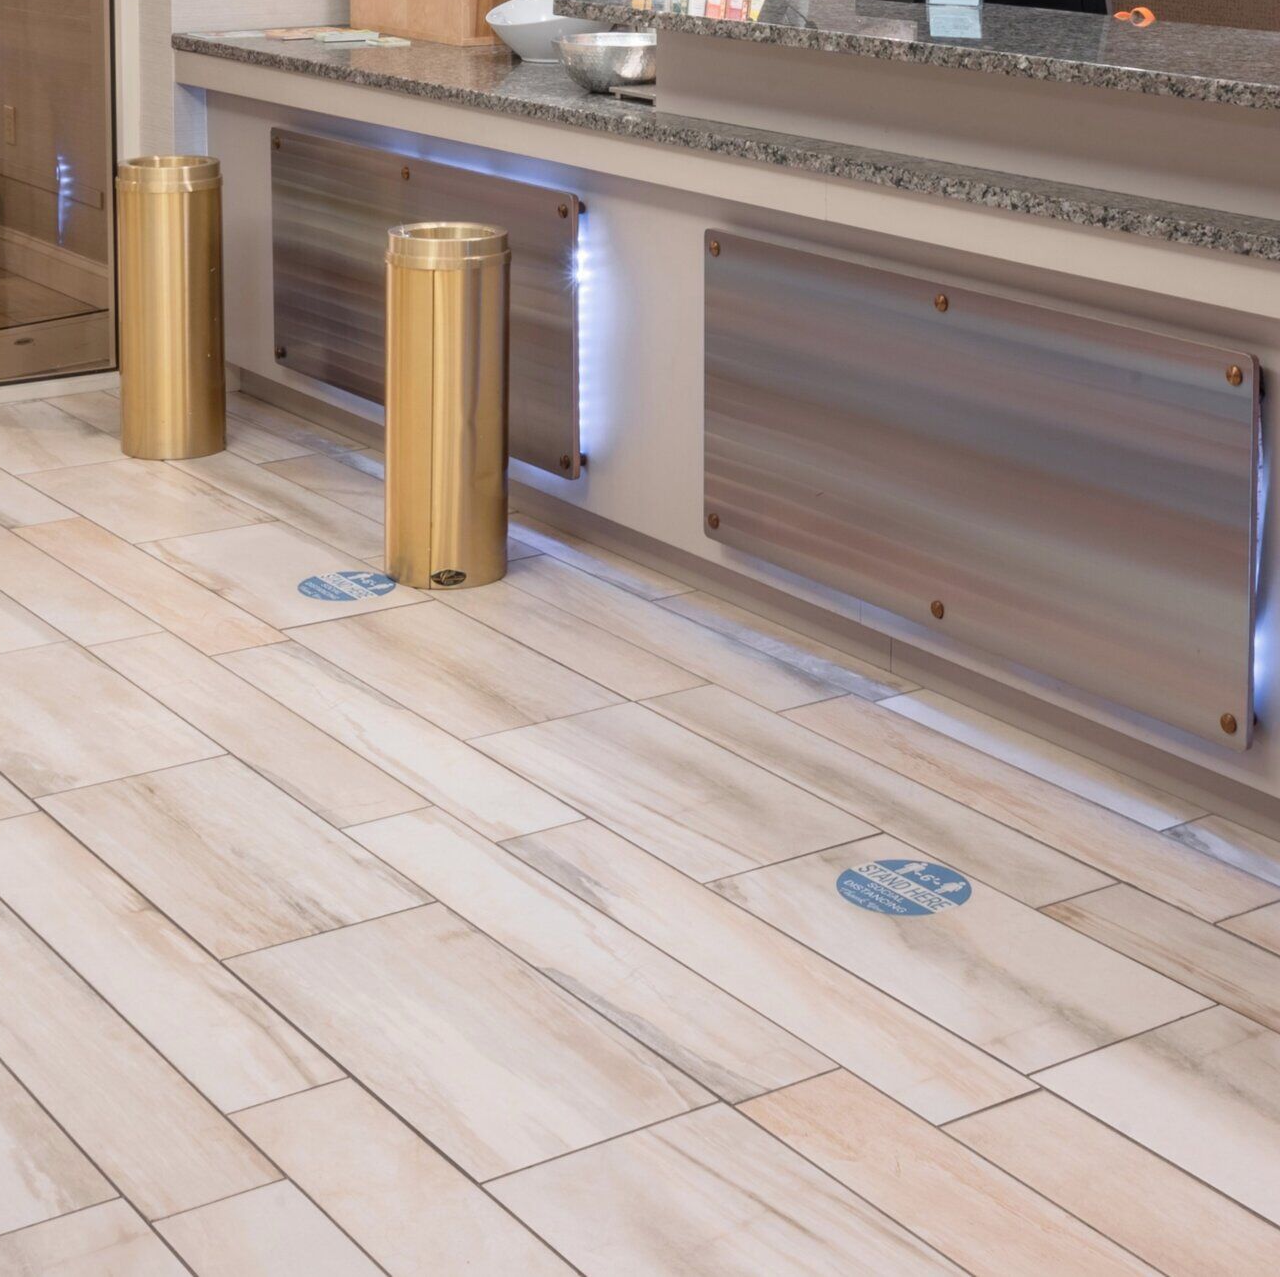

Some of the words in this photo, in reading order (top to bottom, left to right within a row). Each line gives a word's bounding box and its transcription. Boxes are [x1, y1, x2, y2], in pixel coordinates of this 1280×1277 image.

[843, 879, 908, 913] DISTANCING
[858, 864, 912, 890] STAND
[904, 886, 953, 911] HERE
[867, 882, 905, 904] SOCIAL
